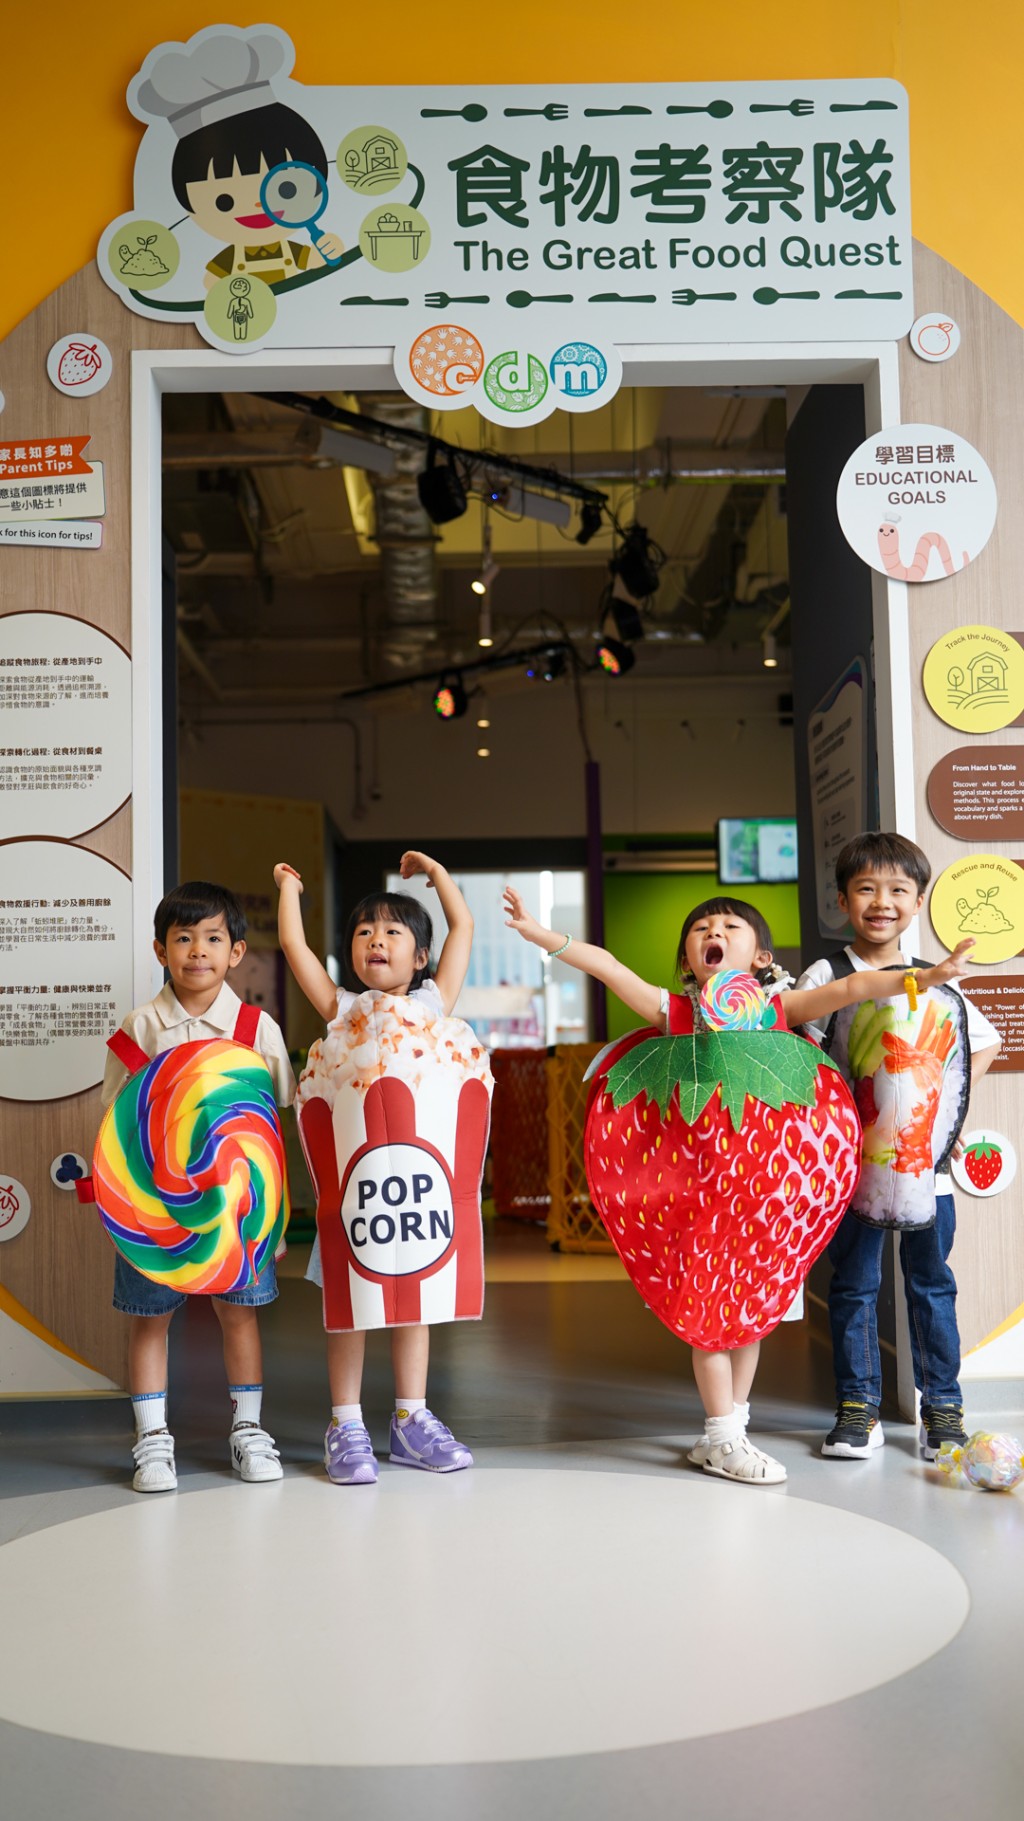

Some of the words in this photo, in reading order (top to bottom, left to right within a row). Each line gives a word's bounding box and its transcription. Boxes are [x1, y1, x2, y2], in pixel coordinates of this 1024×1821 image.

[447, 139, 896, 228] 食物考察隊
[453, 240, 529, 271] The
[543, 239, 658, 270] Great
[669, 236, 766, 269] Food
[780, 235, 902, 269] Quest
[875, 444, 955, 465] 學習目標
[0, 464, 43, 475] Parent
[45, 460, 73, 473] Tips
[855, 470, 978, 486] EDUCATIONAL
[888, 491, 946, 505] GOALS
[5, 528, 17, 537] for
[20, 529, 36, 538] this
[38, 530, 57, 539] icon
[59, 531, 71, 540] for
[73, 532, 93, 541] tips!
[945, 635, 966, 650] Track
[981, 634, 1010, 652] Journey
[952, 864, 978, 880] Rescue
[996, 864, 1018, 882] Reuse
[358, 1173, 433, 1210] POP
[350, 1210, 452, 1247] CORN
